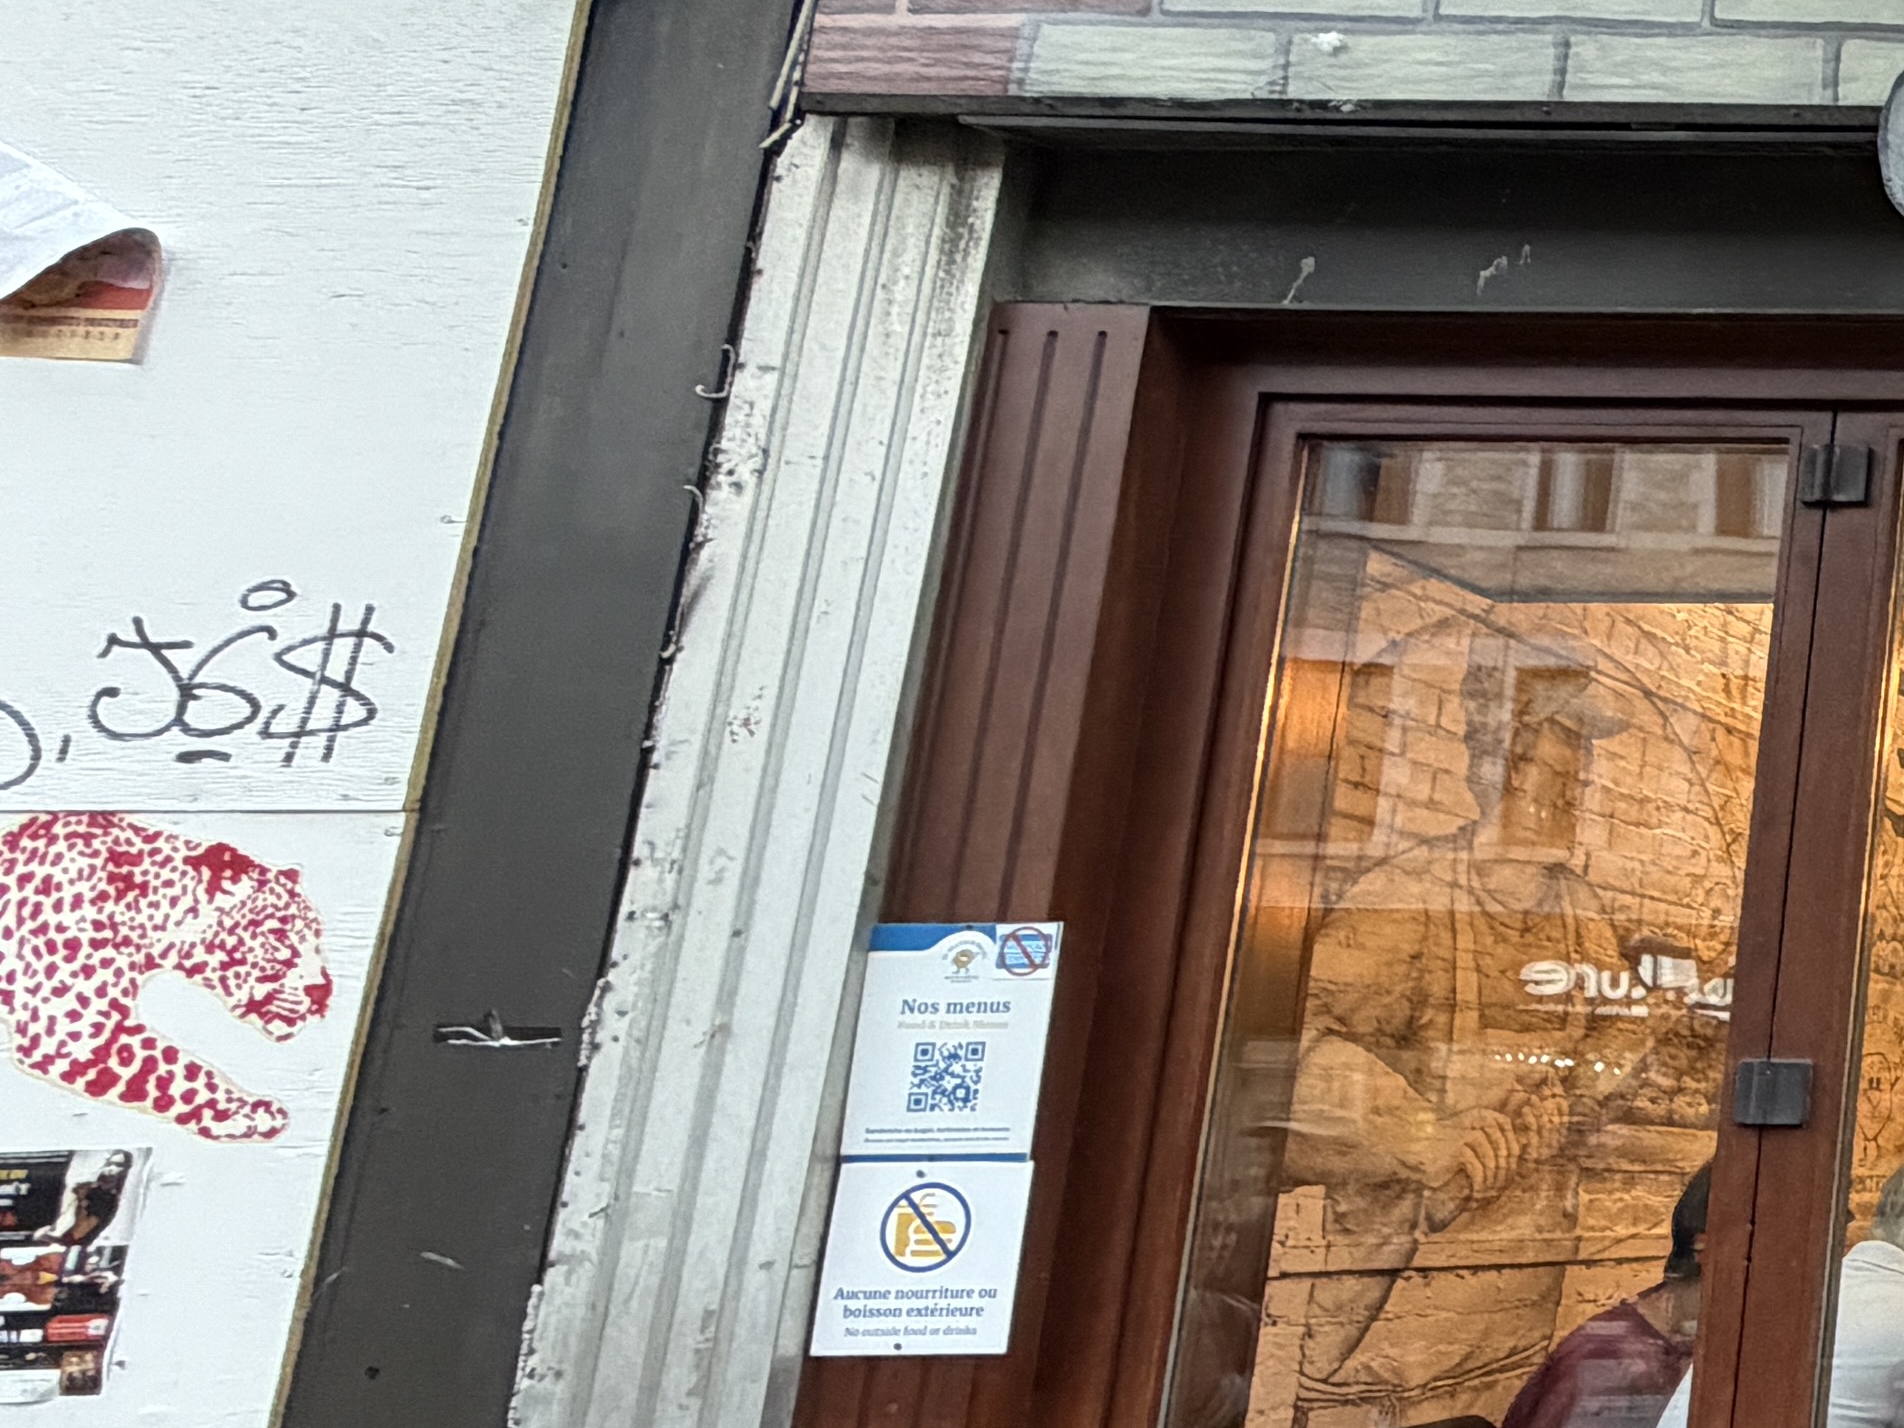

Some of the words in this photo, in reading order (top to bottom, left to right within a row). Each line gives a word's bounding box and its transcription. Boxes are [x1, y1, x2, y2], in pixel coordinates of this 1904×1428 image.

[900, 999, 940, 1015] Nos
[945, 1000, 1012, 1015] menus
[833, 1287, 891, 1300] Aucune
[894, 1286, 975, 1300] nourriture
[978, 1288, 998, 1299] ou
[843, 1304, 902, 1319] boisson
[906, 1303, 985, 1317] extérieure
